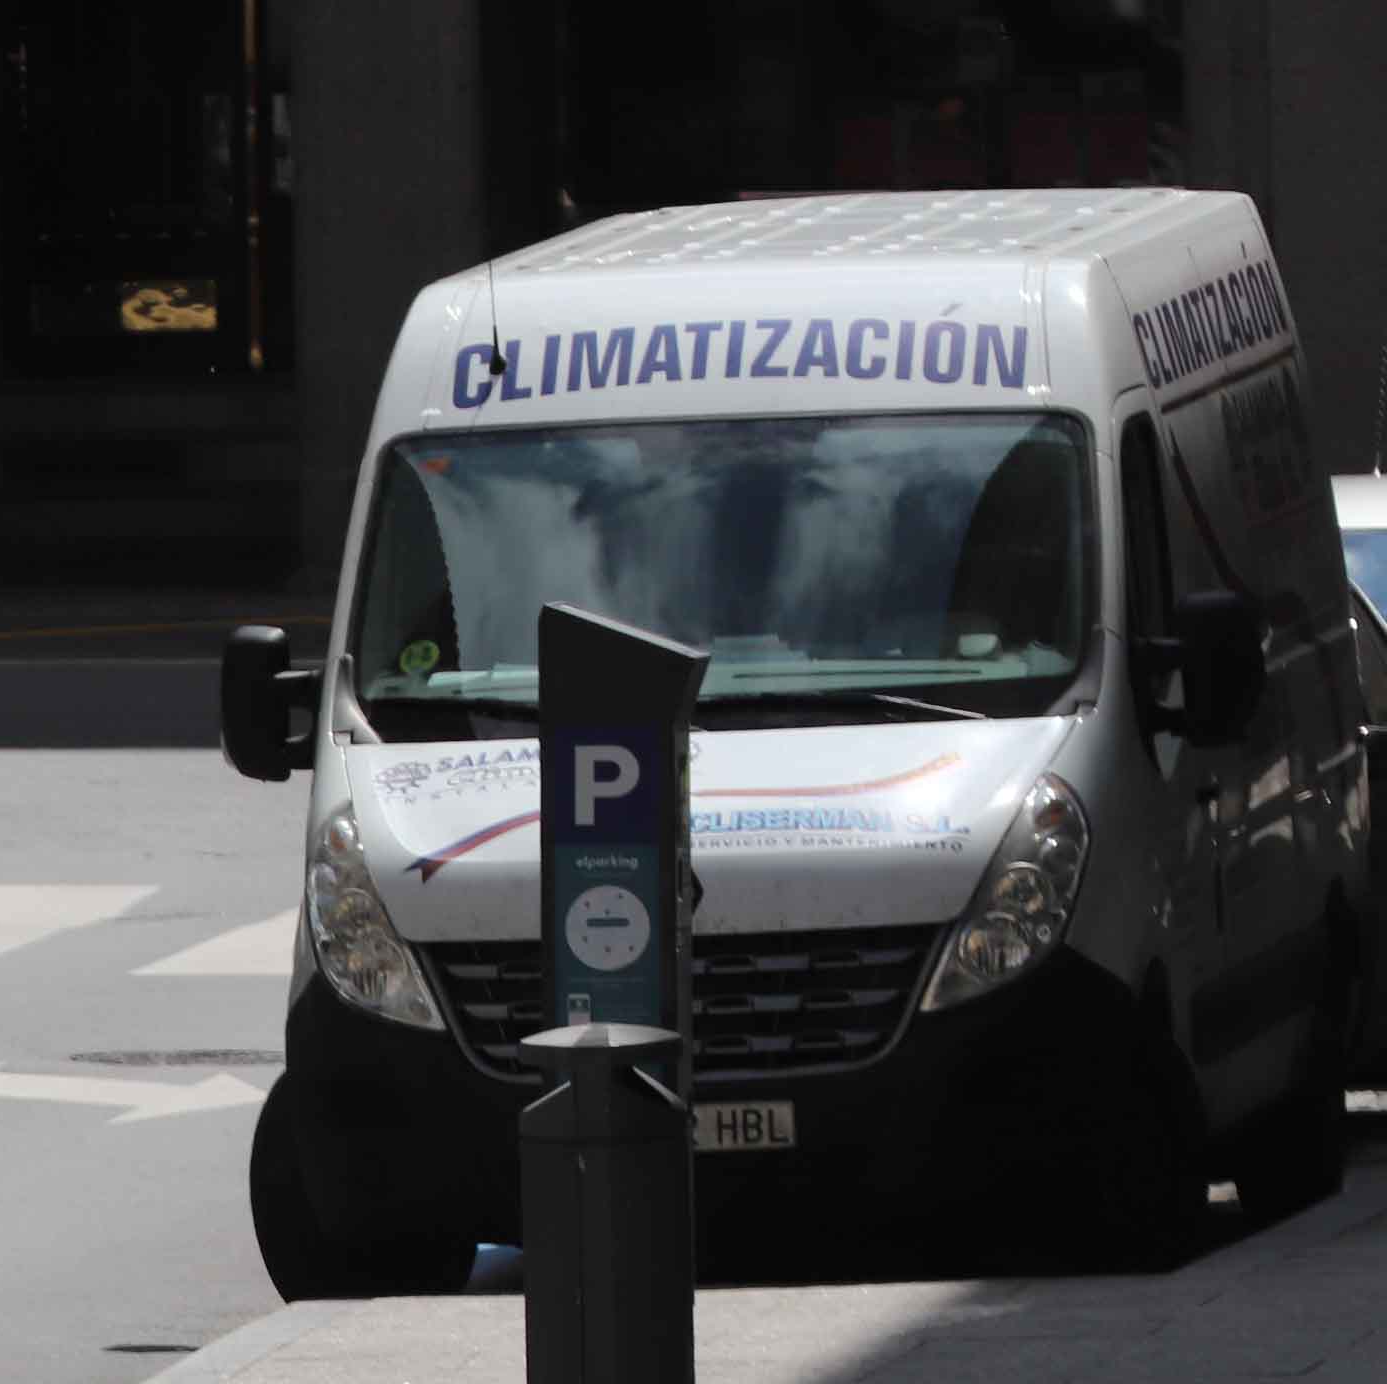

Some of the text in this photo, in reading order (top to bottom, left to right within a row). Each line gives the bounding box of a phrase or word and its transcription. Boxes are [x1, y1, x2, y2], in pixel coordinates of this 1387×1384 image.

[1132, 240, 1289, 389] CLIMATIZACIÓN
[452, 303, 1028, 409] CLIMATIZACIÓN
[574, 745, 640, 827] P
[575, 853, 639, 872] elparking
[716, 1108, 790, 1145] HBL
